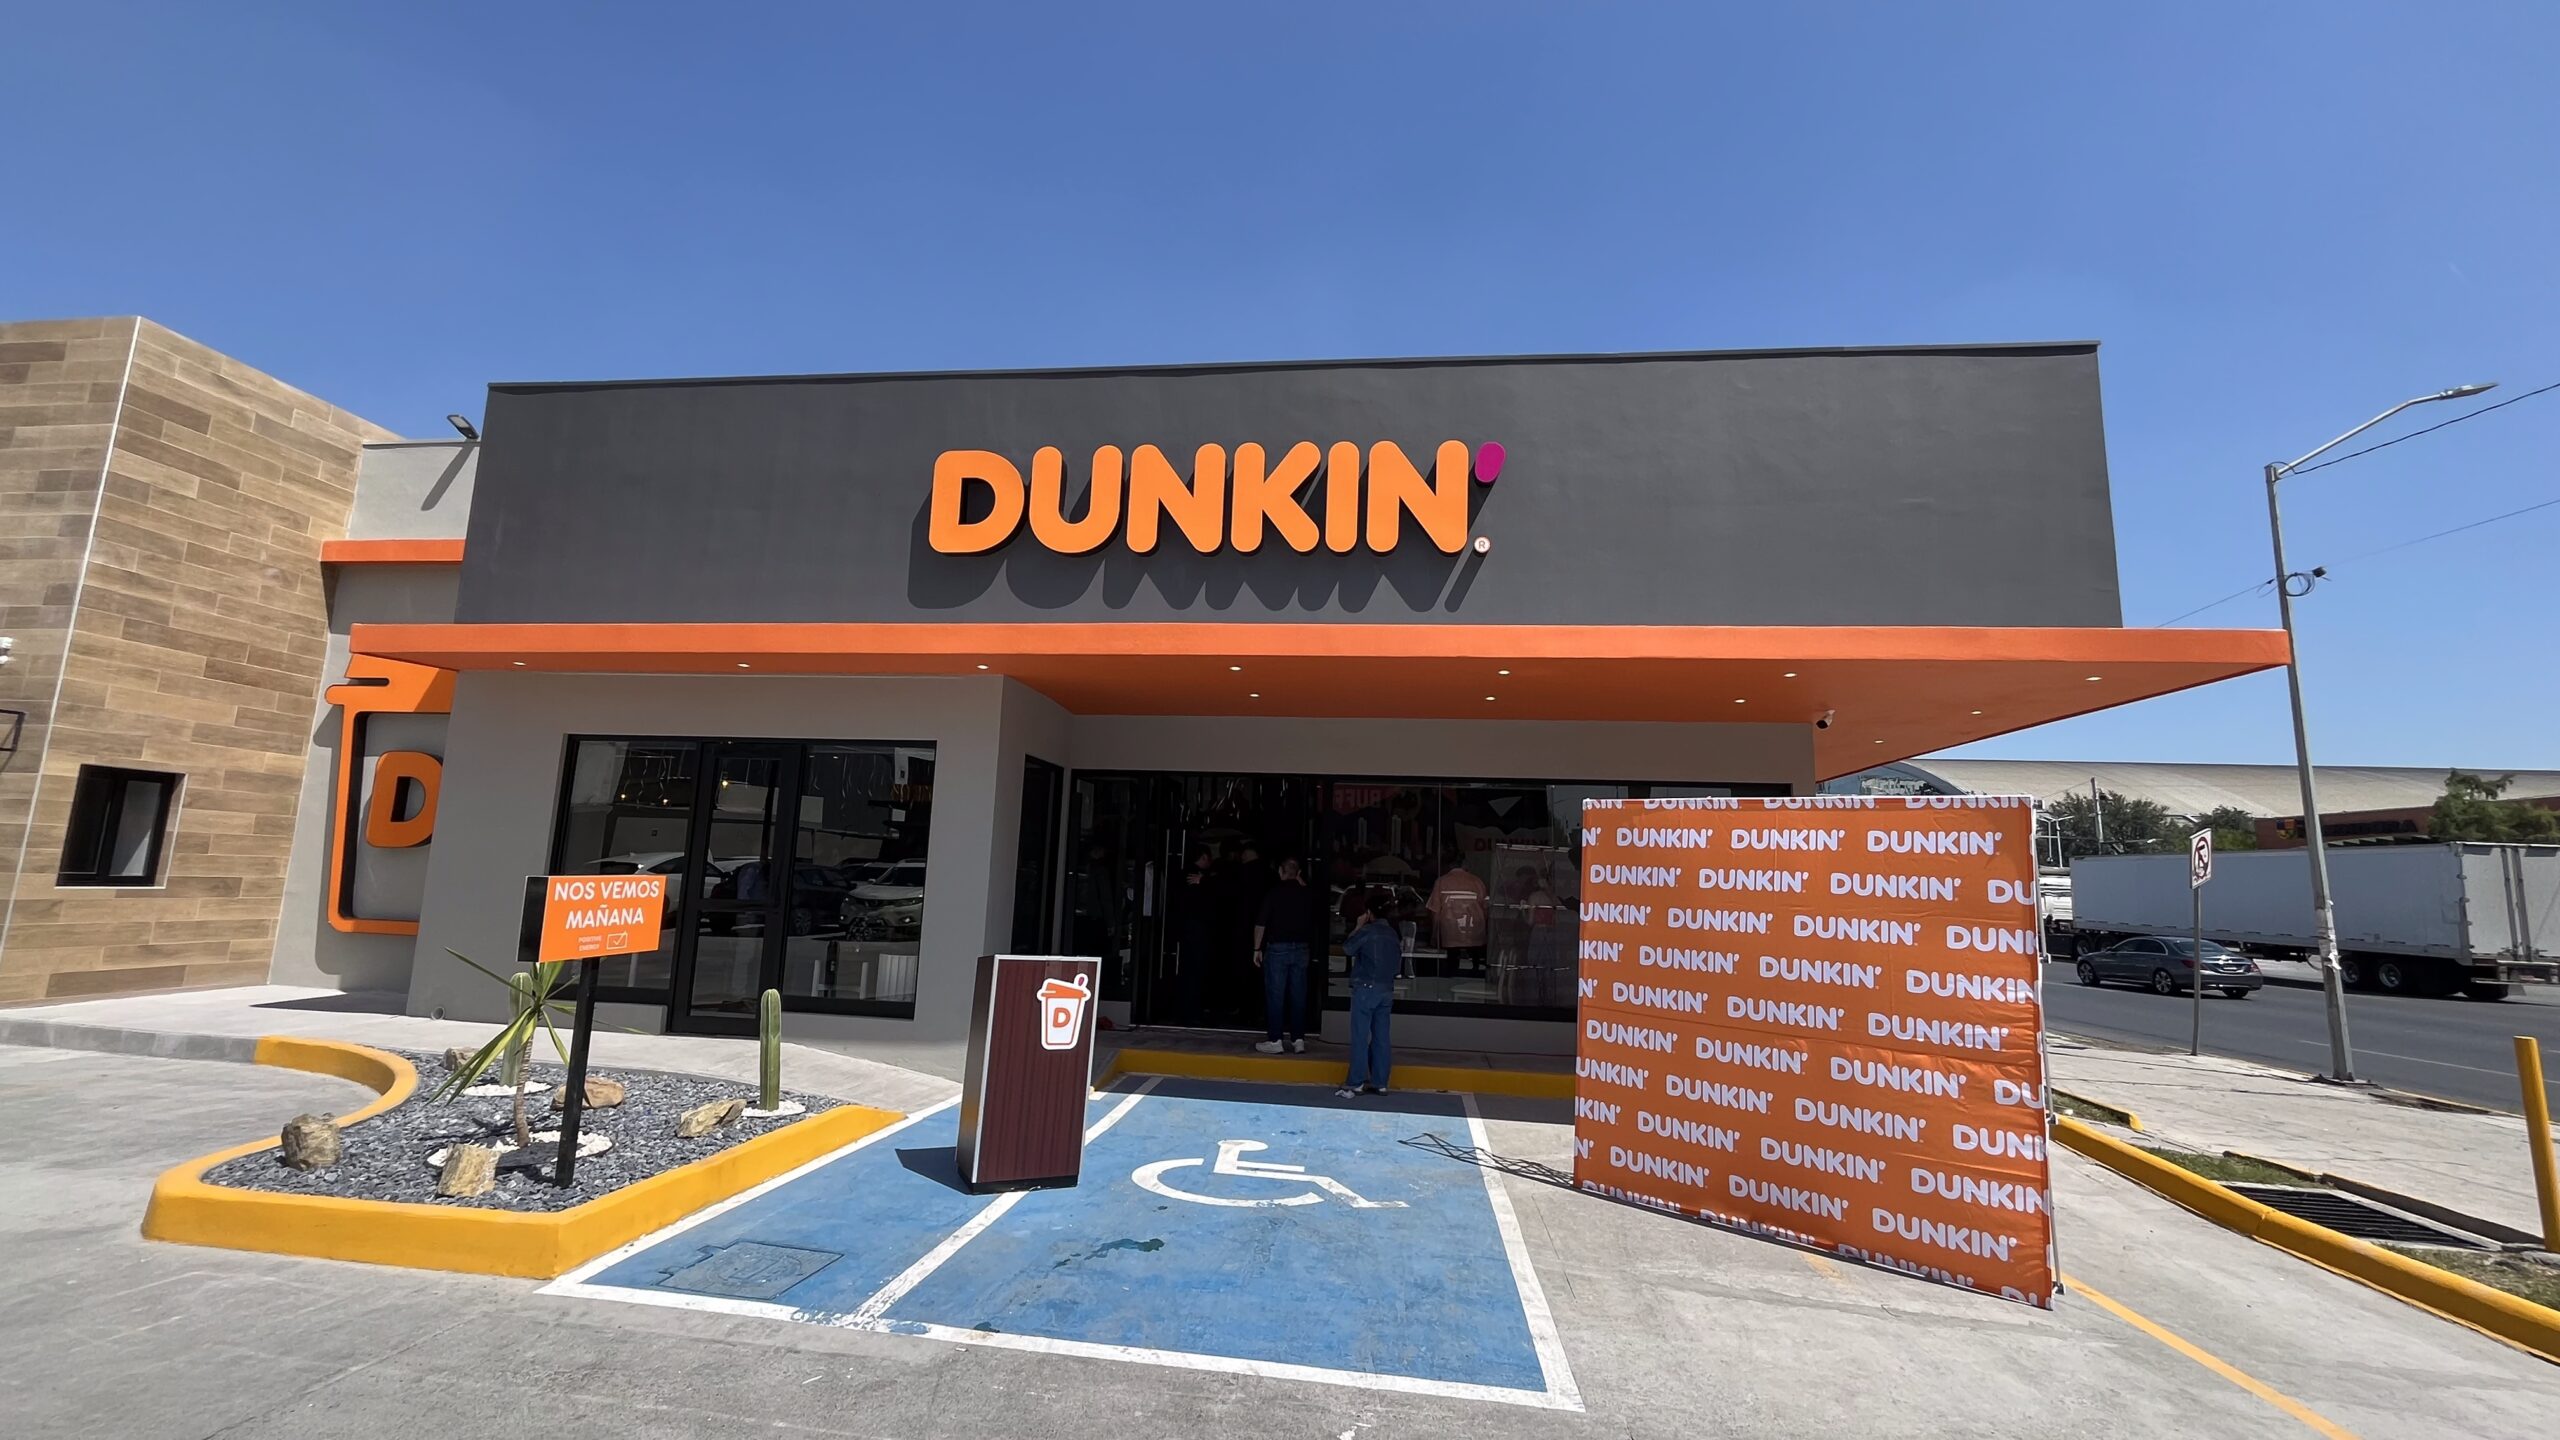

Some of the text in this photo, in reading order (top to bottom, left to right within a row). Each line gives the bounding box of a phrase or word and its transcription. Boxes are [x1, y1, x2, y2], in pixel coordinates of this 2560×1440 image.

[929, 440, 1507, 554] DUNKIN'
[366, 751, 443, 848] D
[1616, 827, 1714, 849] DUNKIN'
[1730, 828, 1846, 852] DUNKIN'
[1866, 829, 2003, 856] DUNKIN'
[554, 880, 660, 902] NOS VEMOS
[1589, 863, 1682, 888] DUNKIN'
[1698, 867, 1809, 894] DUNKIN'
[1830, 872, 1962, 902] DUNKIN'
[566, 904, 644, 929] MAÑANA
[1667, 907, 1774, 935] DUNKIN'
[1793, 914, 1922, 946] DUNKIN'
[1638, 945, 1740, 975] DUNKIN'
[1759, 955, 1883, 989] DUNKIN'
[1052, 1007, 1071, 1028] D
[1612, 981, 1709, 1014] DUNKIN'
[1726, 995, 1845, 1031] DUNKIN'
[1867, 1012, 2010, 1052] DUNKIN'
[1586, 1019, 1678, 1054] DUNKIN'
[1695, 1036, 1809, 1075] DUNKIN'
[1830, 1056, 1968, 1099] DUNKIN'
[1665, 1074, 1774, 1115] DUNKIN'
[1794, 1097, 1927, 1143] DUNKIN'
[1637, 1110, 1741, 1153] DUNKIN'
[1760, 1136, 1887, 1184] DUNKIN'
[1609, 1145, 1710, 1188] DUNKIN'
[1728, 1174, 1849, 1221] DUNKIN'
[1872, 1207, 2018, 1262] DUNKIN'
